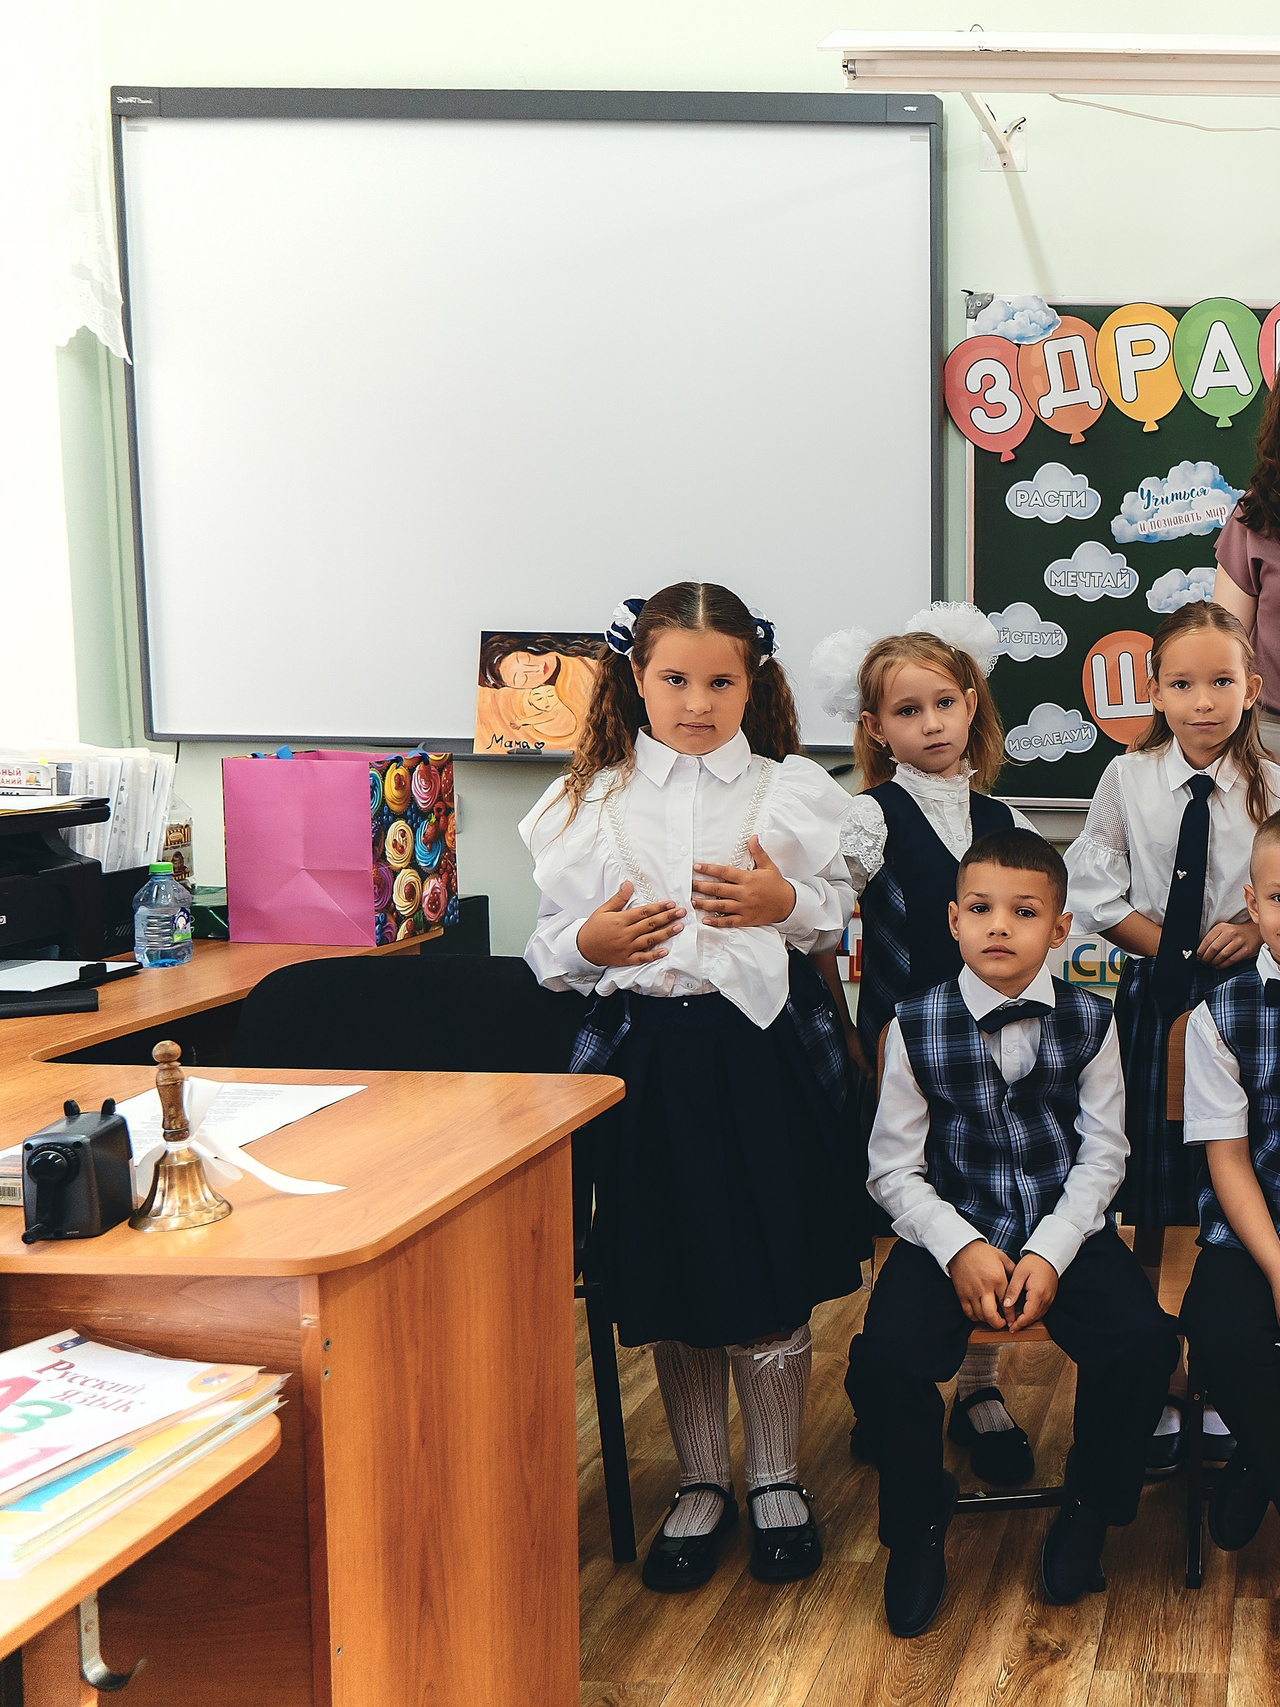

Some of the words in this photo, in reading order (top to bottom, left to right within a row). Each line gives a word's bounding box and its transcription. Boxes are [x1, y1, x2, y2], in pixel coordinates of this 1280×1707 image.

[1015, 490, 1087, 508] РАСТИ
[1140, 487, 1210, 510] Учиться
[1139, 523, 1147, 532] и
[1150, 512, 1202, 531] познавать
[1205, 506, 1226, 523] мир
[1049, 568, 1130, 589] МЕЧТАЙ
[486, 733, 530, 750] Мама
[1008, 725, 1093, 752] ИССЛЕДУЙ
[33, 1359, 147, 1395] Русский
